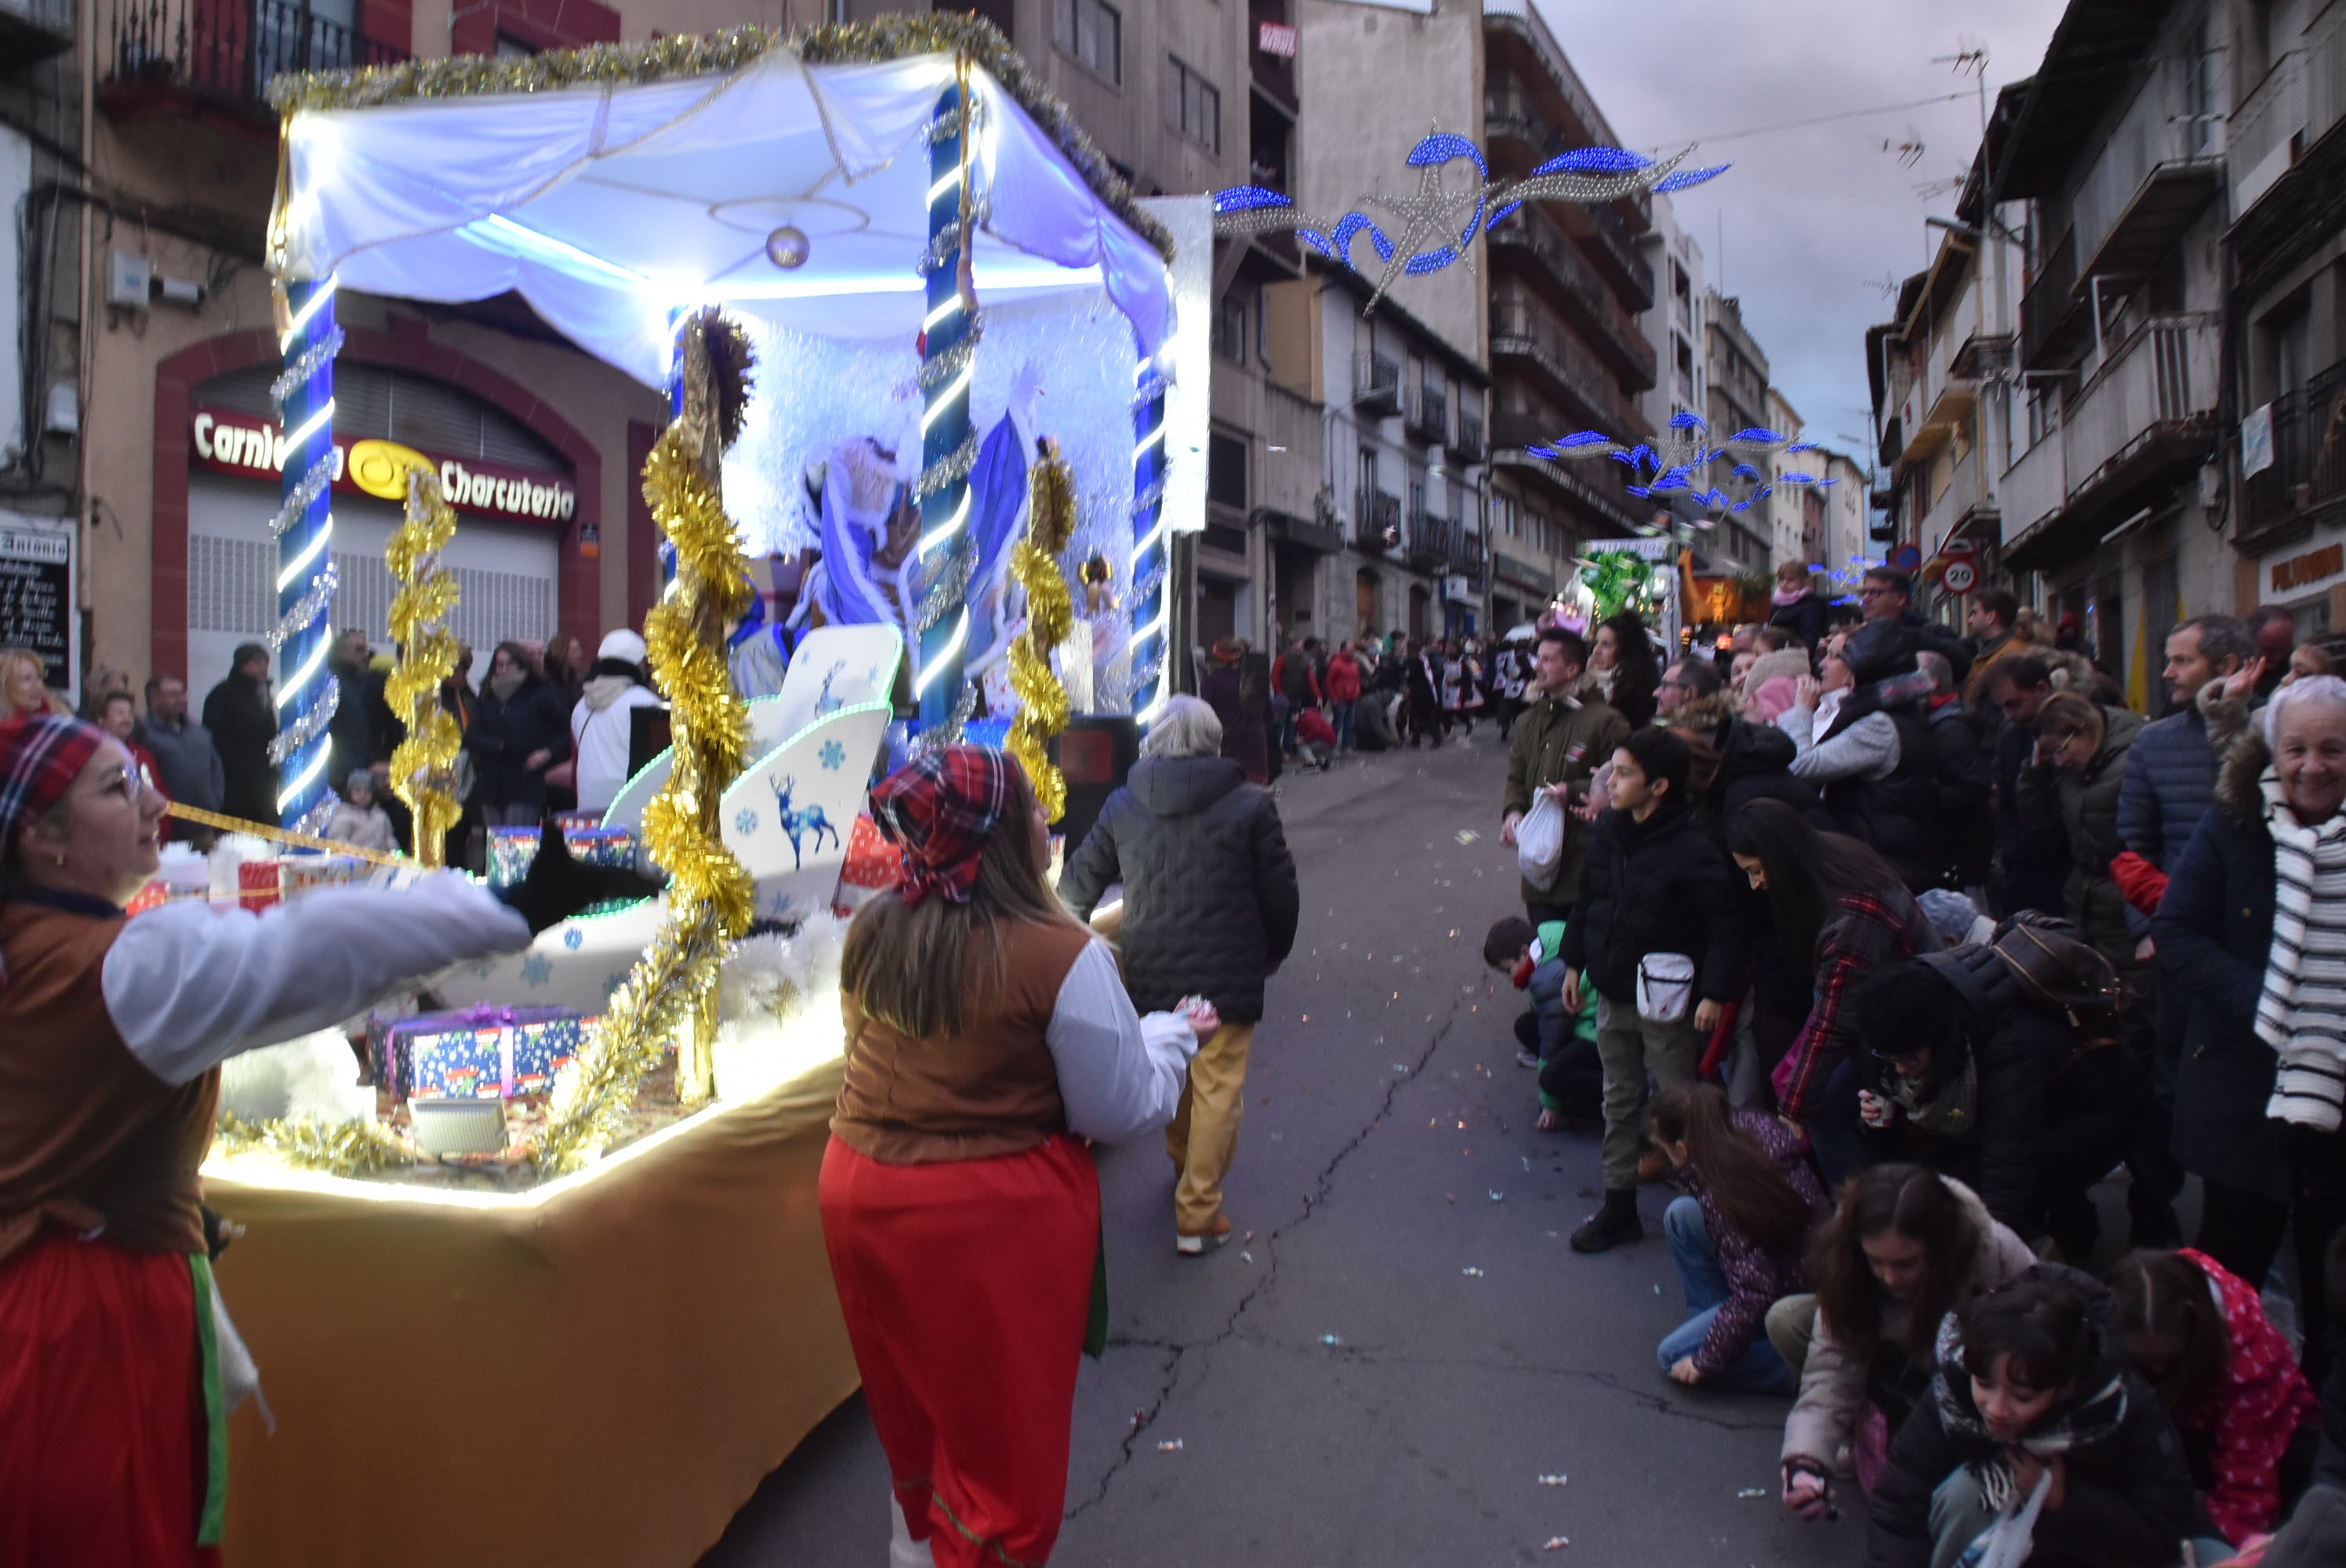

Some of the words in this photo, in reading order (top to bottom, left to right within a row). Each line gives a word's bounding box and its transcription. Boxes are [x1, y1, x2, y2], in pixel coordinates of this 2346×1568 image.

[194, 412, 344, 482] Carnic
[2, 531, 67, 557] Antonio
[1950, 569, 1970, 583] 20
